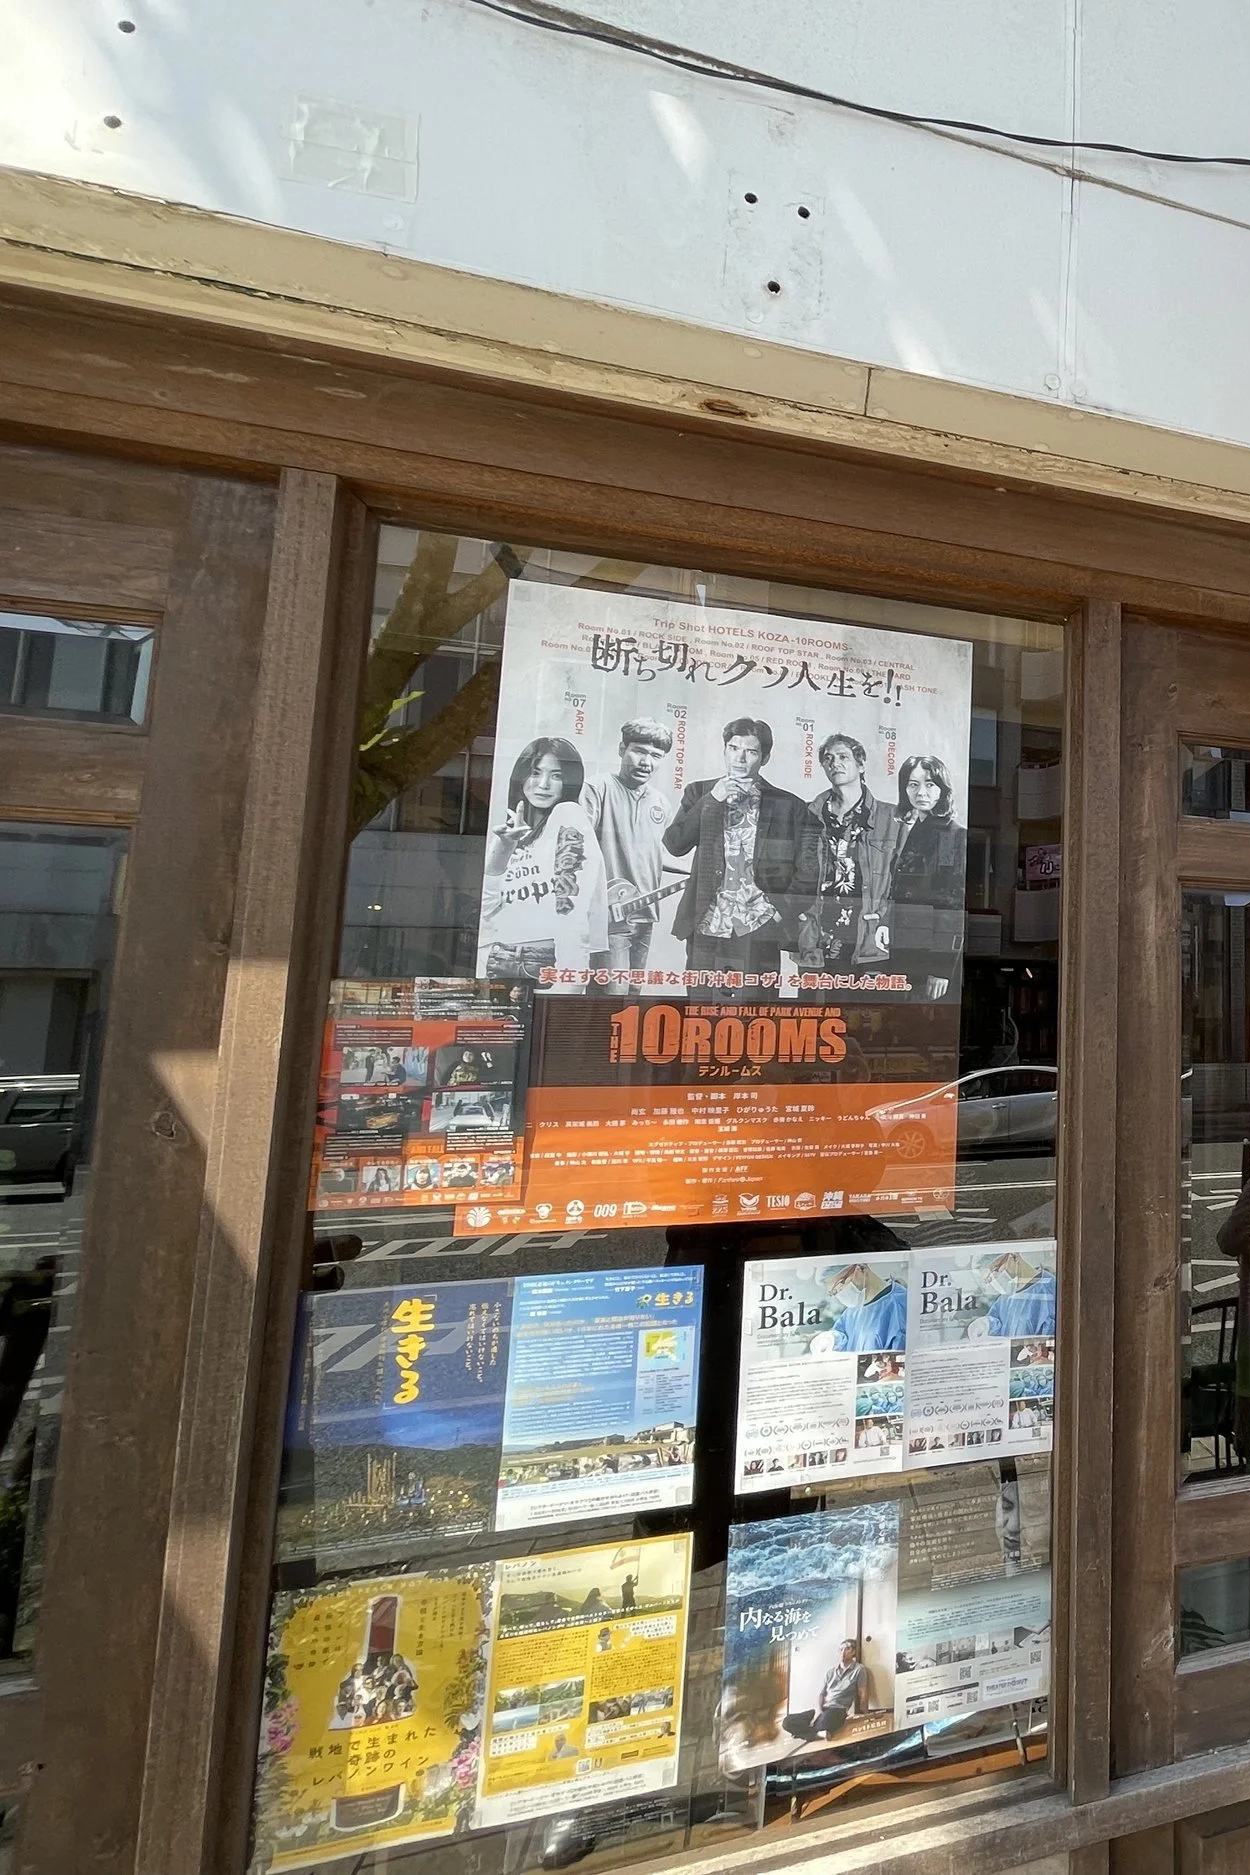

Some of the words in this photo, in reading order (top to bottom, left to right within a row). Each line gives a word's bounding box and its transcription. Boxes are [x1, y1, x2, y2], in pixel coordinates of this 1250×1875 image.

[653, 618, 676, 630] Trip
[679, 622, 705, 632] Shot
[708, 626, 754, 638] HOTELS
[758, 631, 789, 643] KOZA
[578, 623, 605, 632] Room
[638, 631, 665, 640] ROCK
[667, 634, 688, 643] SIDE
[694, 637, 719, 646] Room
[751, 644, 776, 653] ROOF
[797, 650, 819, 658] STAR
[826, 653, 849, 662] Room
[878, 660, 916, 670] CENTRAL
[541, 640, 568, 650] Room
[917, 686, 938, 694] TONE
[572, 699, 586, 708] 07
[674, 710, 687, 719] 02
[575, 709, 585, 735] ARCH
[677, 720, 686, 748] ROOF
[803, 723, 814, 732] 01
[804, 733, 814, 758] ROCK
[885, 731, 897, 740] 08
[676, 749, 685, 766] TOP
[804, 760, 812, 779] SIDE
[887, 741, 896, 776] DECORA
[674, 766, 684, 790] STAR
[738, 1006, 758, 1017] FALL
[770, 1006, 792, 1017] PARK
[825, 1006, 841, 1017] AND
[609, 1023, 620, 1063] THE
[698, 1065, 762, 1077] テンルームス
[766, 1195, 790, 1207] TESIO
[920, 1270, 953, 1288] Dr.
[654, 1291, 695, 1307] 生きる
[759, 1284, 793, 1302] Dr.
[919, 1288, 979, 1316] Bala
[757, 1302, 823, 1330] Bala
[390, 1298, 436, 1405] 生きる
[739, 1606, 812, 1633] 内なる海を
[768, 1625, 820, 1644] 見つめて
[308, 1726, 437, 1760] 戦地で生まれた
[348, 1748, 396, 1767] 奇跡の
[312, 1756, 430, 1787] レバノンワイン
